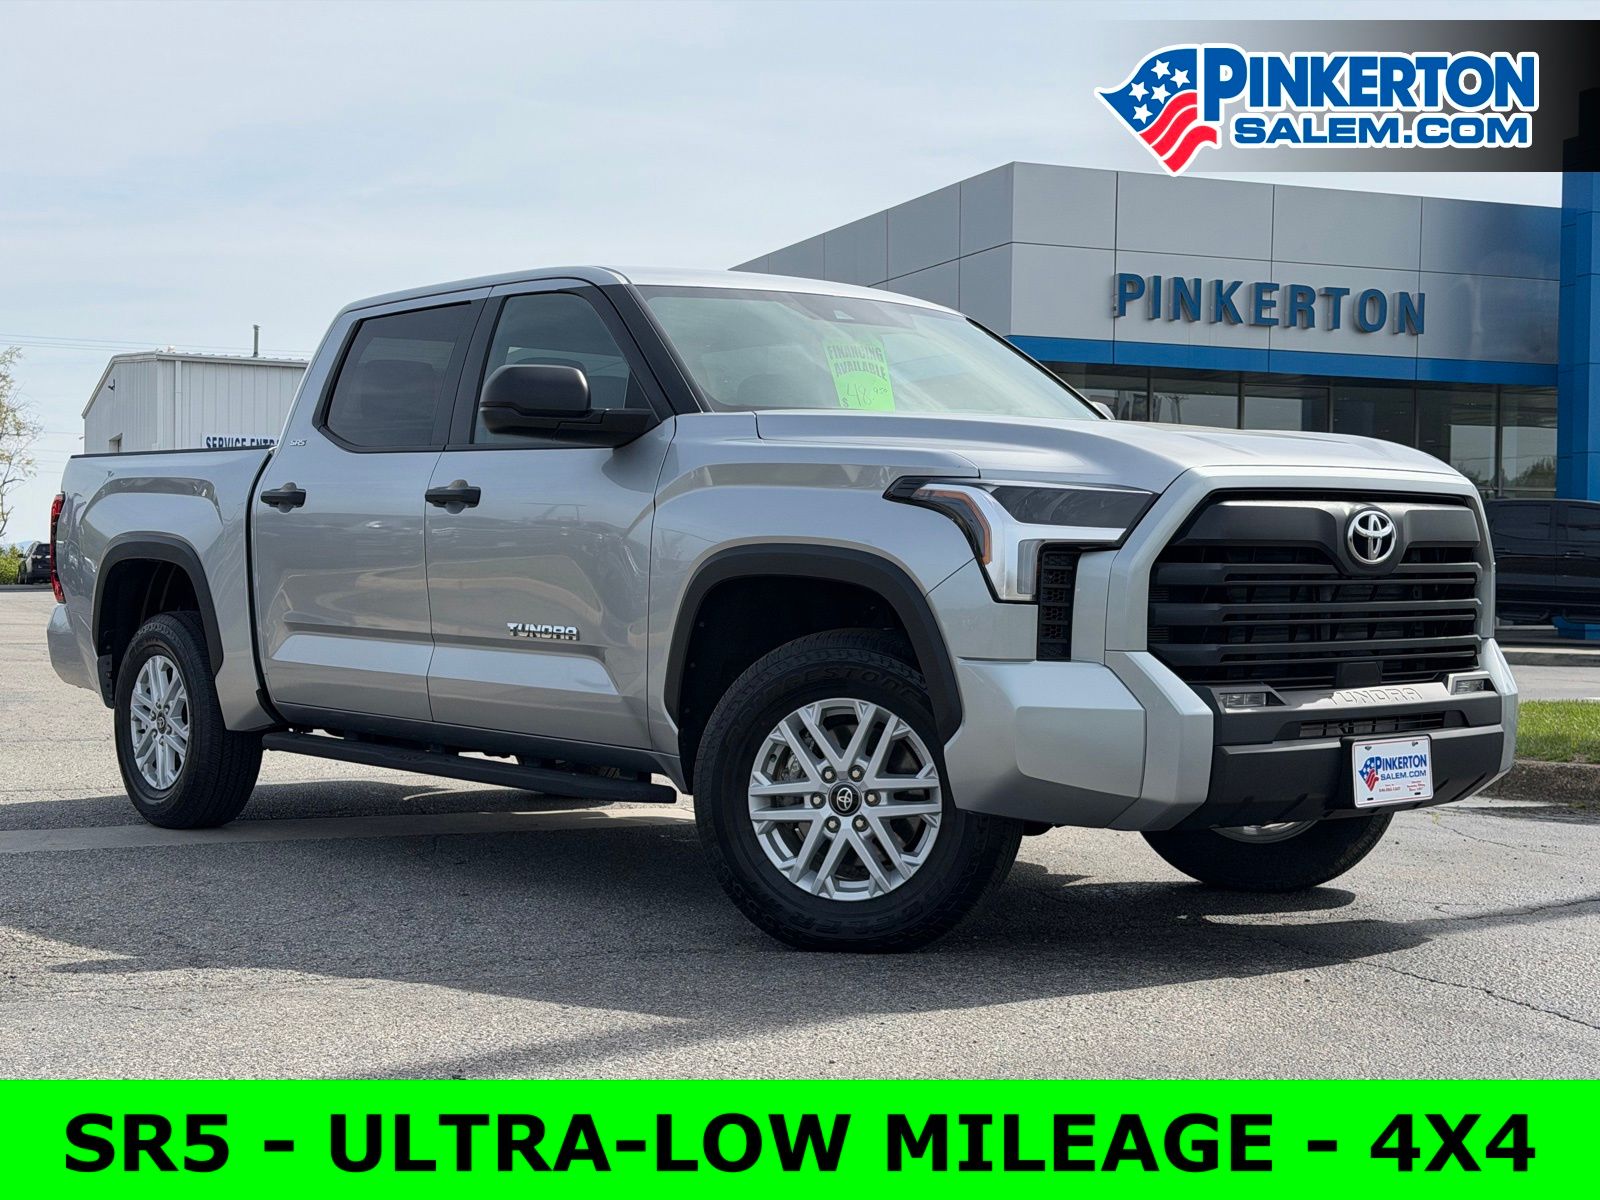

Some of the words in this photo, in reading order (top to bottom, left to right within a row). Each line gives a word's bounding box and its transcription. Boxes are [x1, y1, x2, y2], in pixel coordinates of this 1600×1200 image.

[1113, 272, 1426, 335] PINKERTON
[827, 345, 884, 362] FINANCING
[834, 361, 887, 381] AVAILABLE
[507, 622, 579, 641] TUNDRA
[1328, 687, 1423, 705] TUNDRA
[1375, 754, 1427, 775] PINKERTON
[1380, 770, 1427, 780] SALEM.COM
